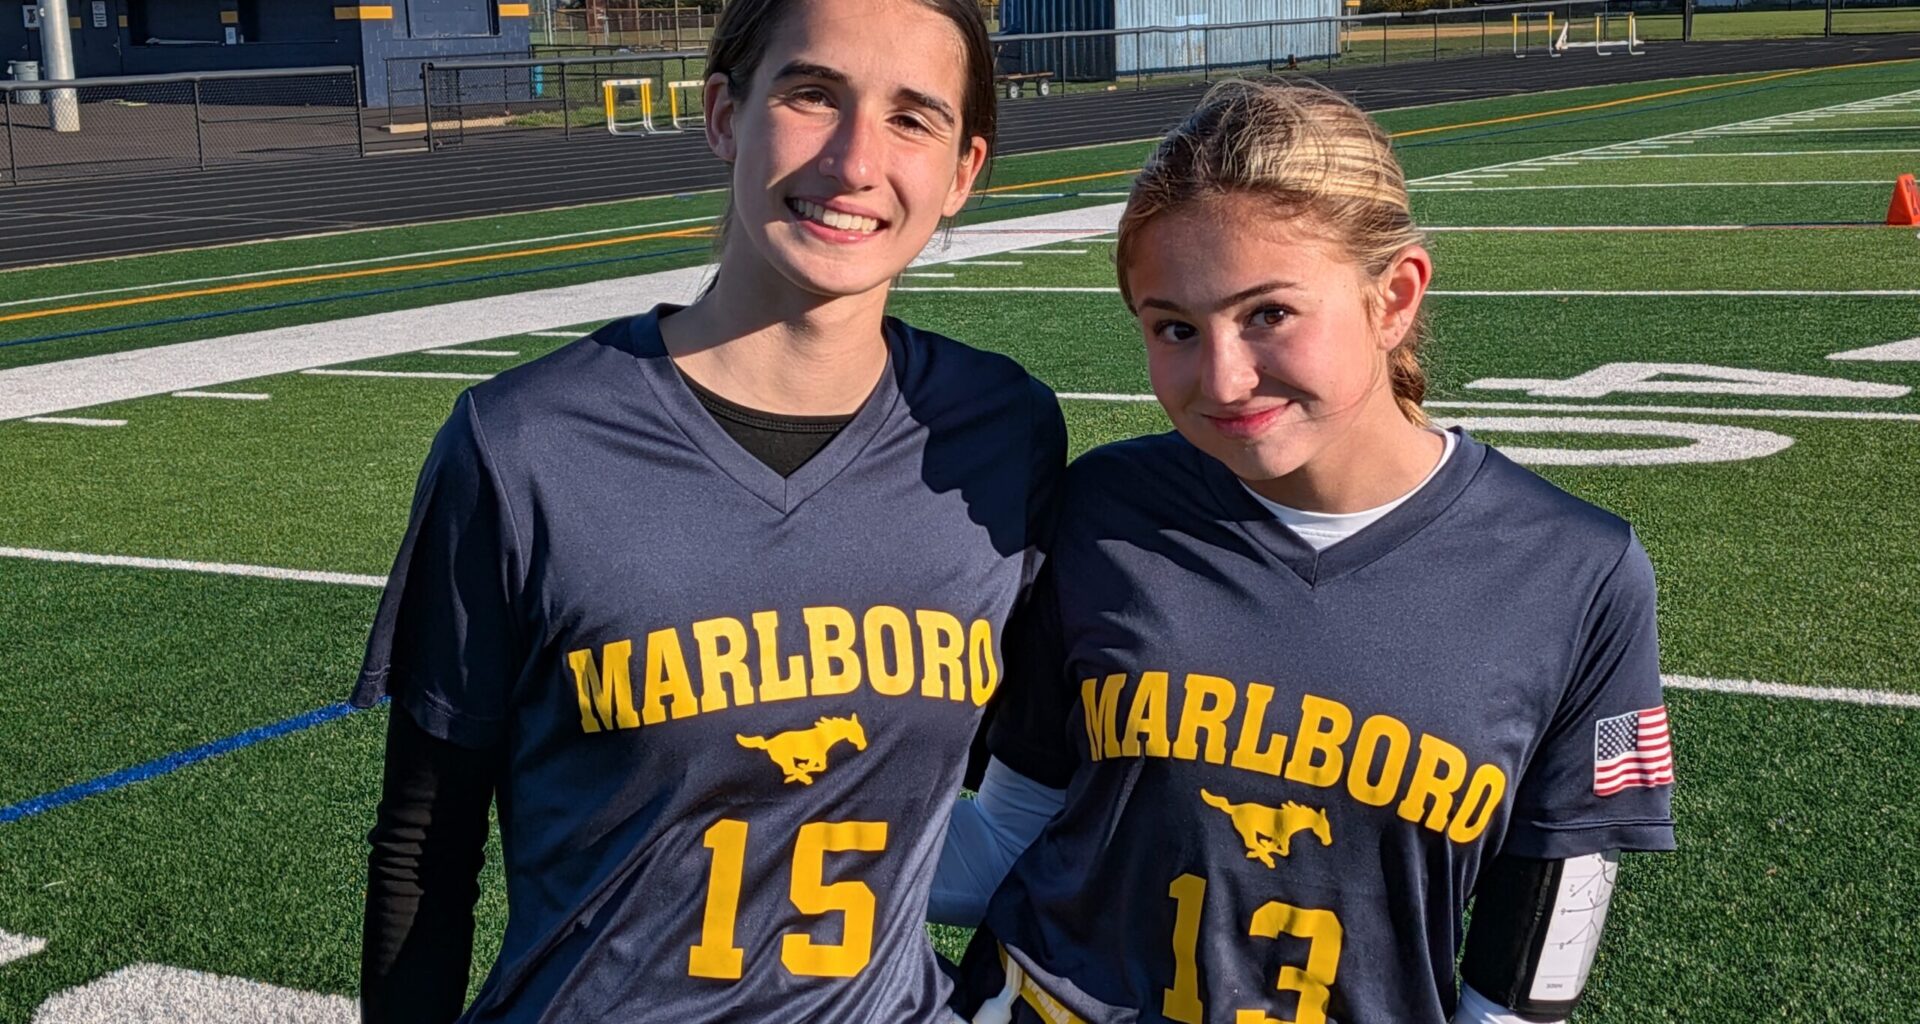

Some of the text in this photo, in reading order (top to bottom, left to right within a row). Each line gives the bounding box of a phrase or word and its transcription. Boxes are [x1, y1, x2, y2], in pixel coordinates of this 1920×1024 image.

[567, 604, 999, 733] MARLBORO
[1080, 671, 1507, 844] MARLBORO
[688, 818, 889, 980] 15
[1162, 872, 1344, 1024] 13
